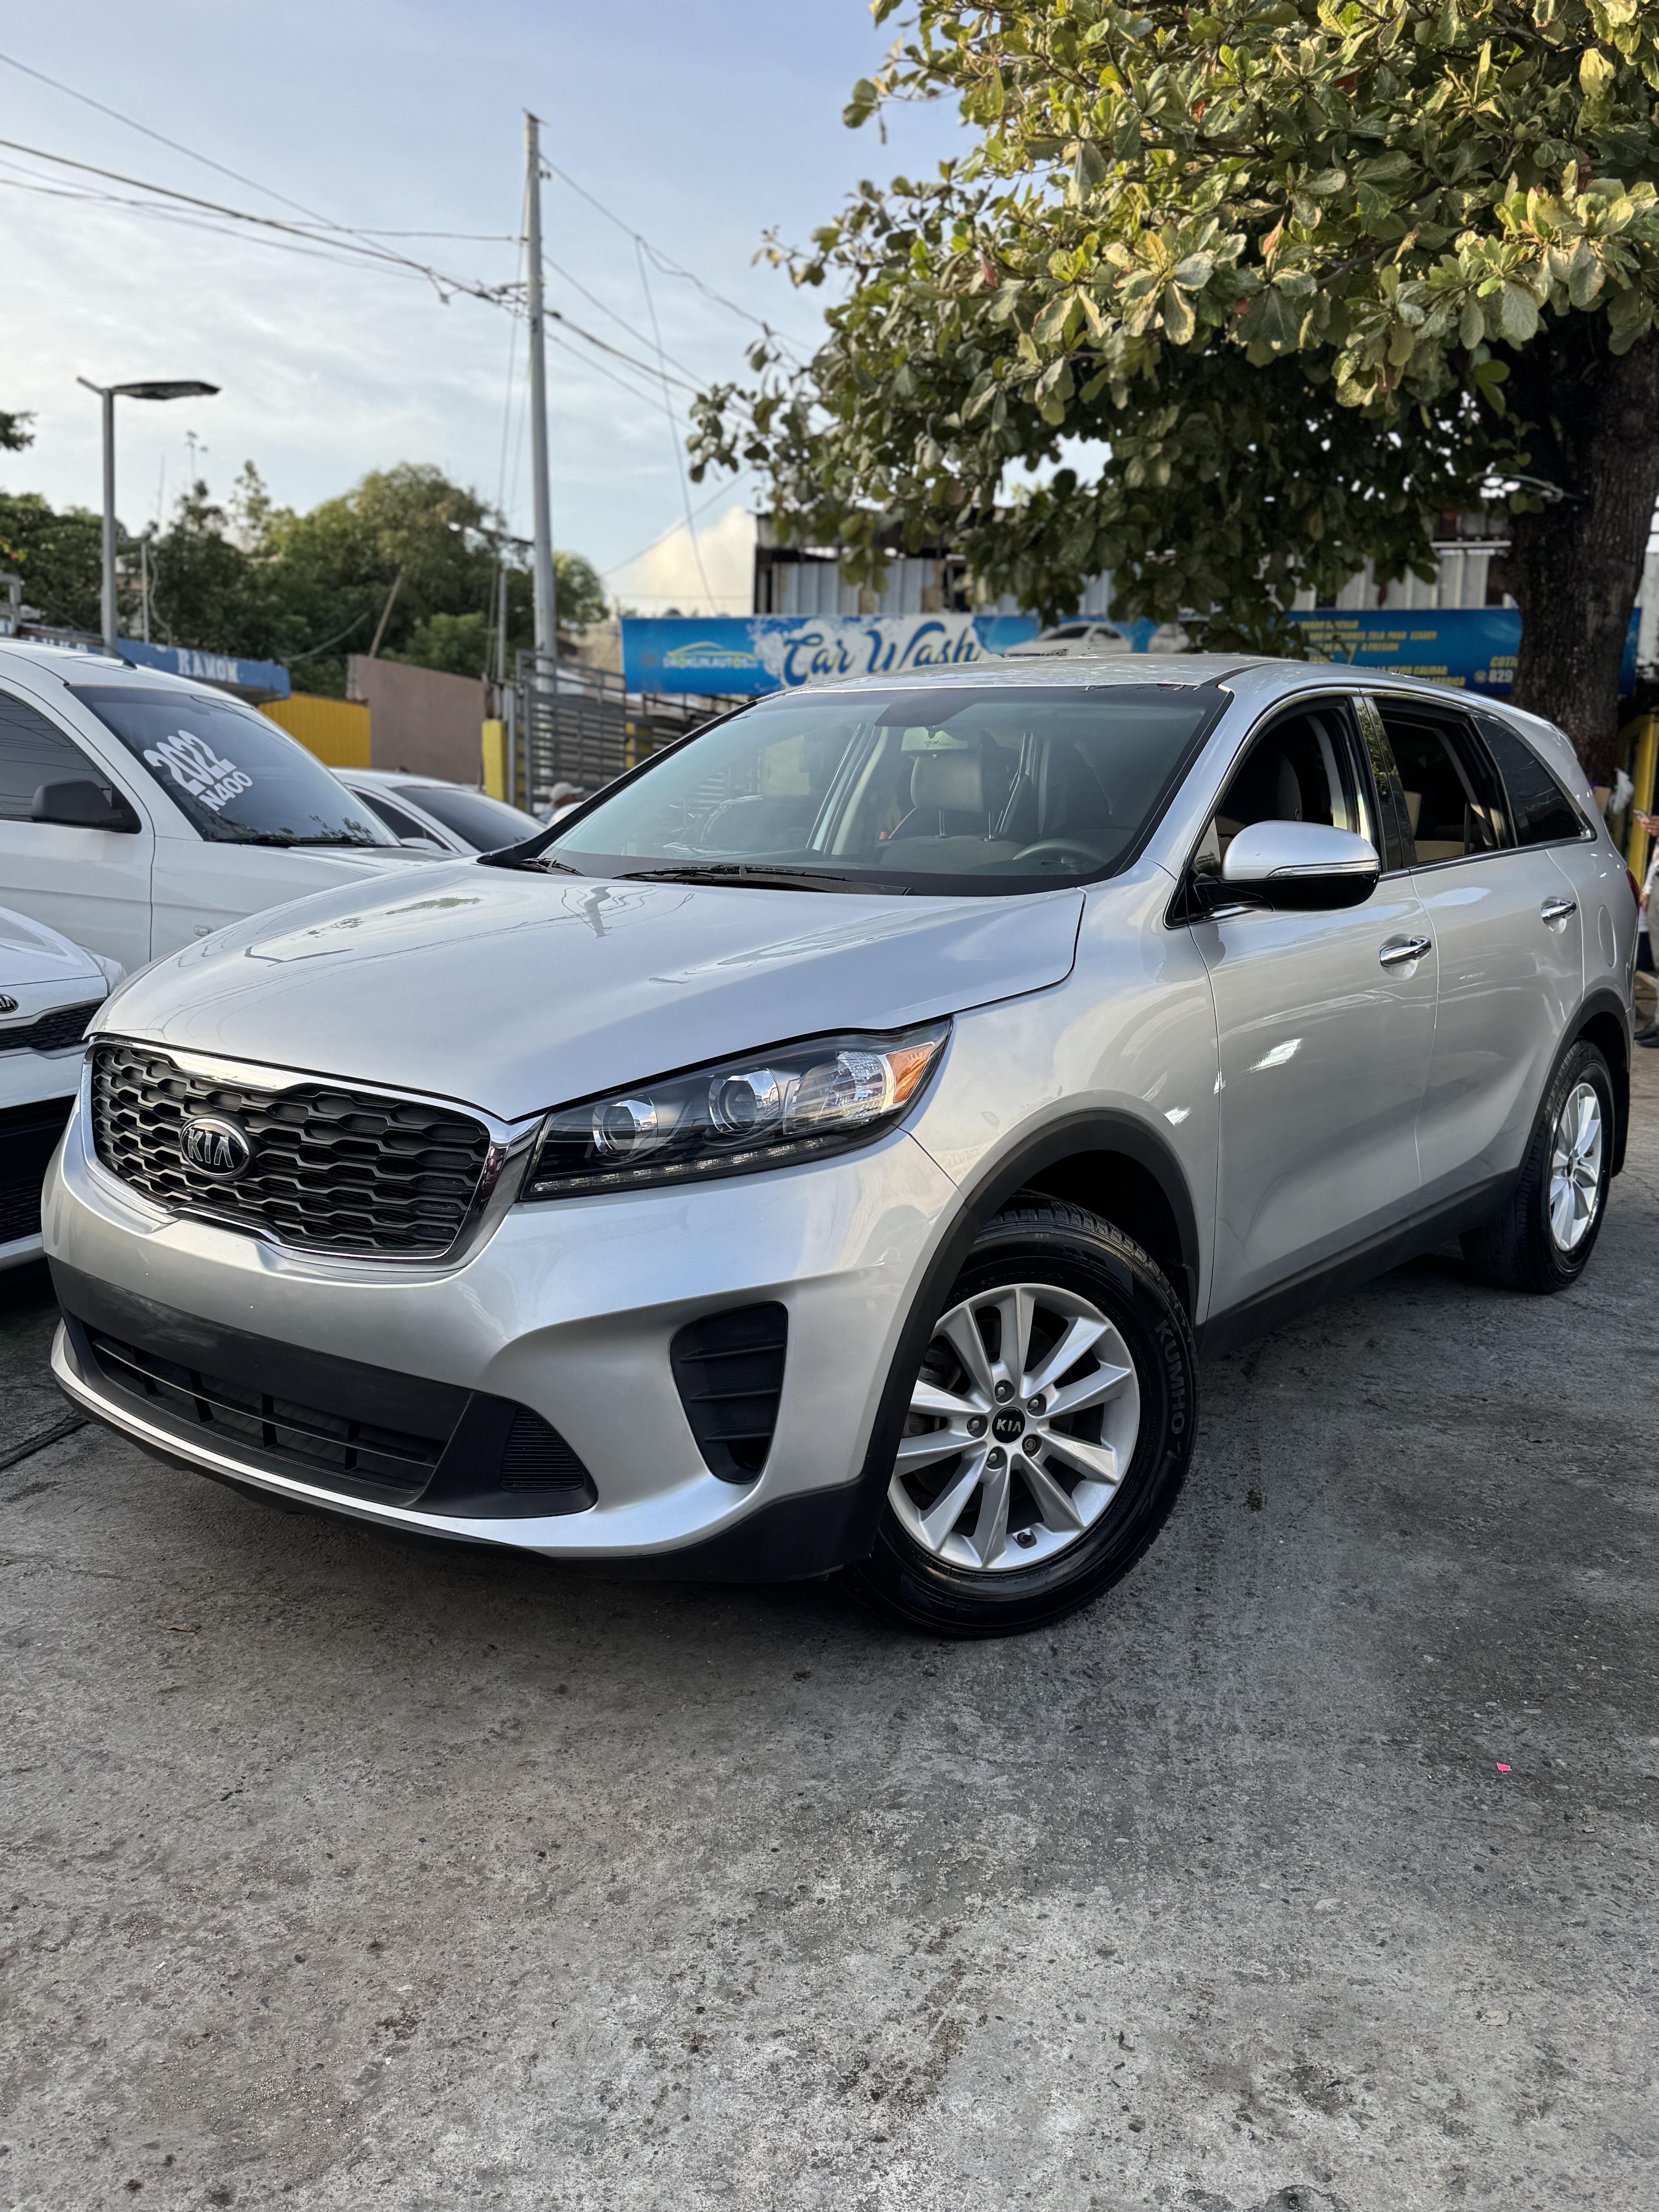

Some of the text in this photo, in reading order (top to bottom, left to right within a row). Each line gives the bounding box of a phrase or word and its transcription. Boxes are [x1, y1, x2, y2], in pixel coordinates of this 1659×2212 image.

[785, 621, 979, 687] Car Wash
[1489, 669, 1513, 683] 829
[143, 730, 237, 796] 2022
[198, 771, 252, 811] N400
[0, 996, 15, 1008] IA
[188, 1128, 234, 1168] KIA
[1154, 1319, 1185, 1434] KUMHO
[996, 1419, 1021, 1432] KIA
